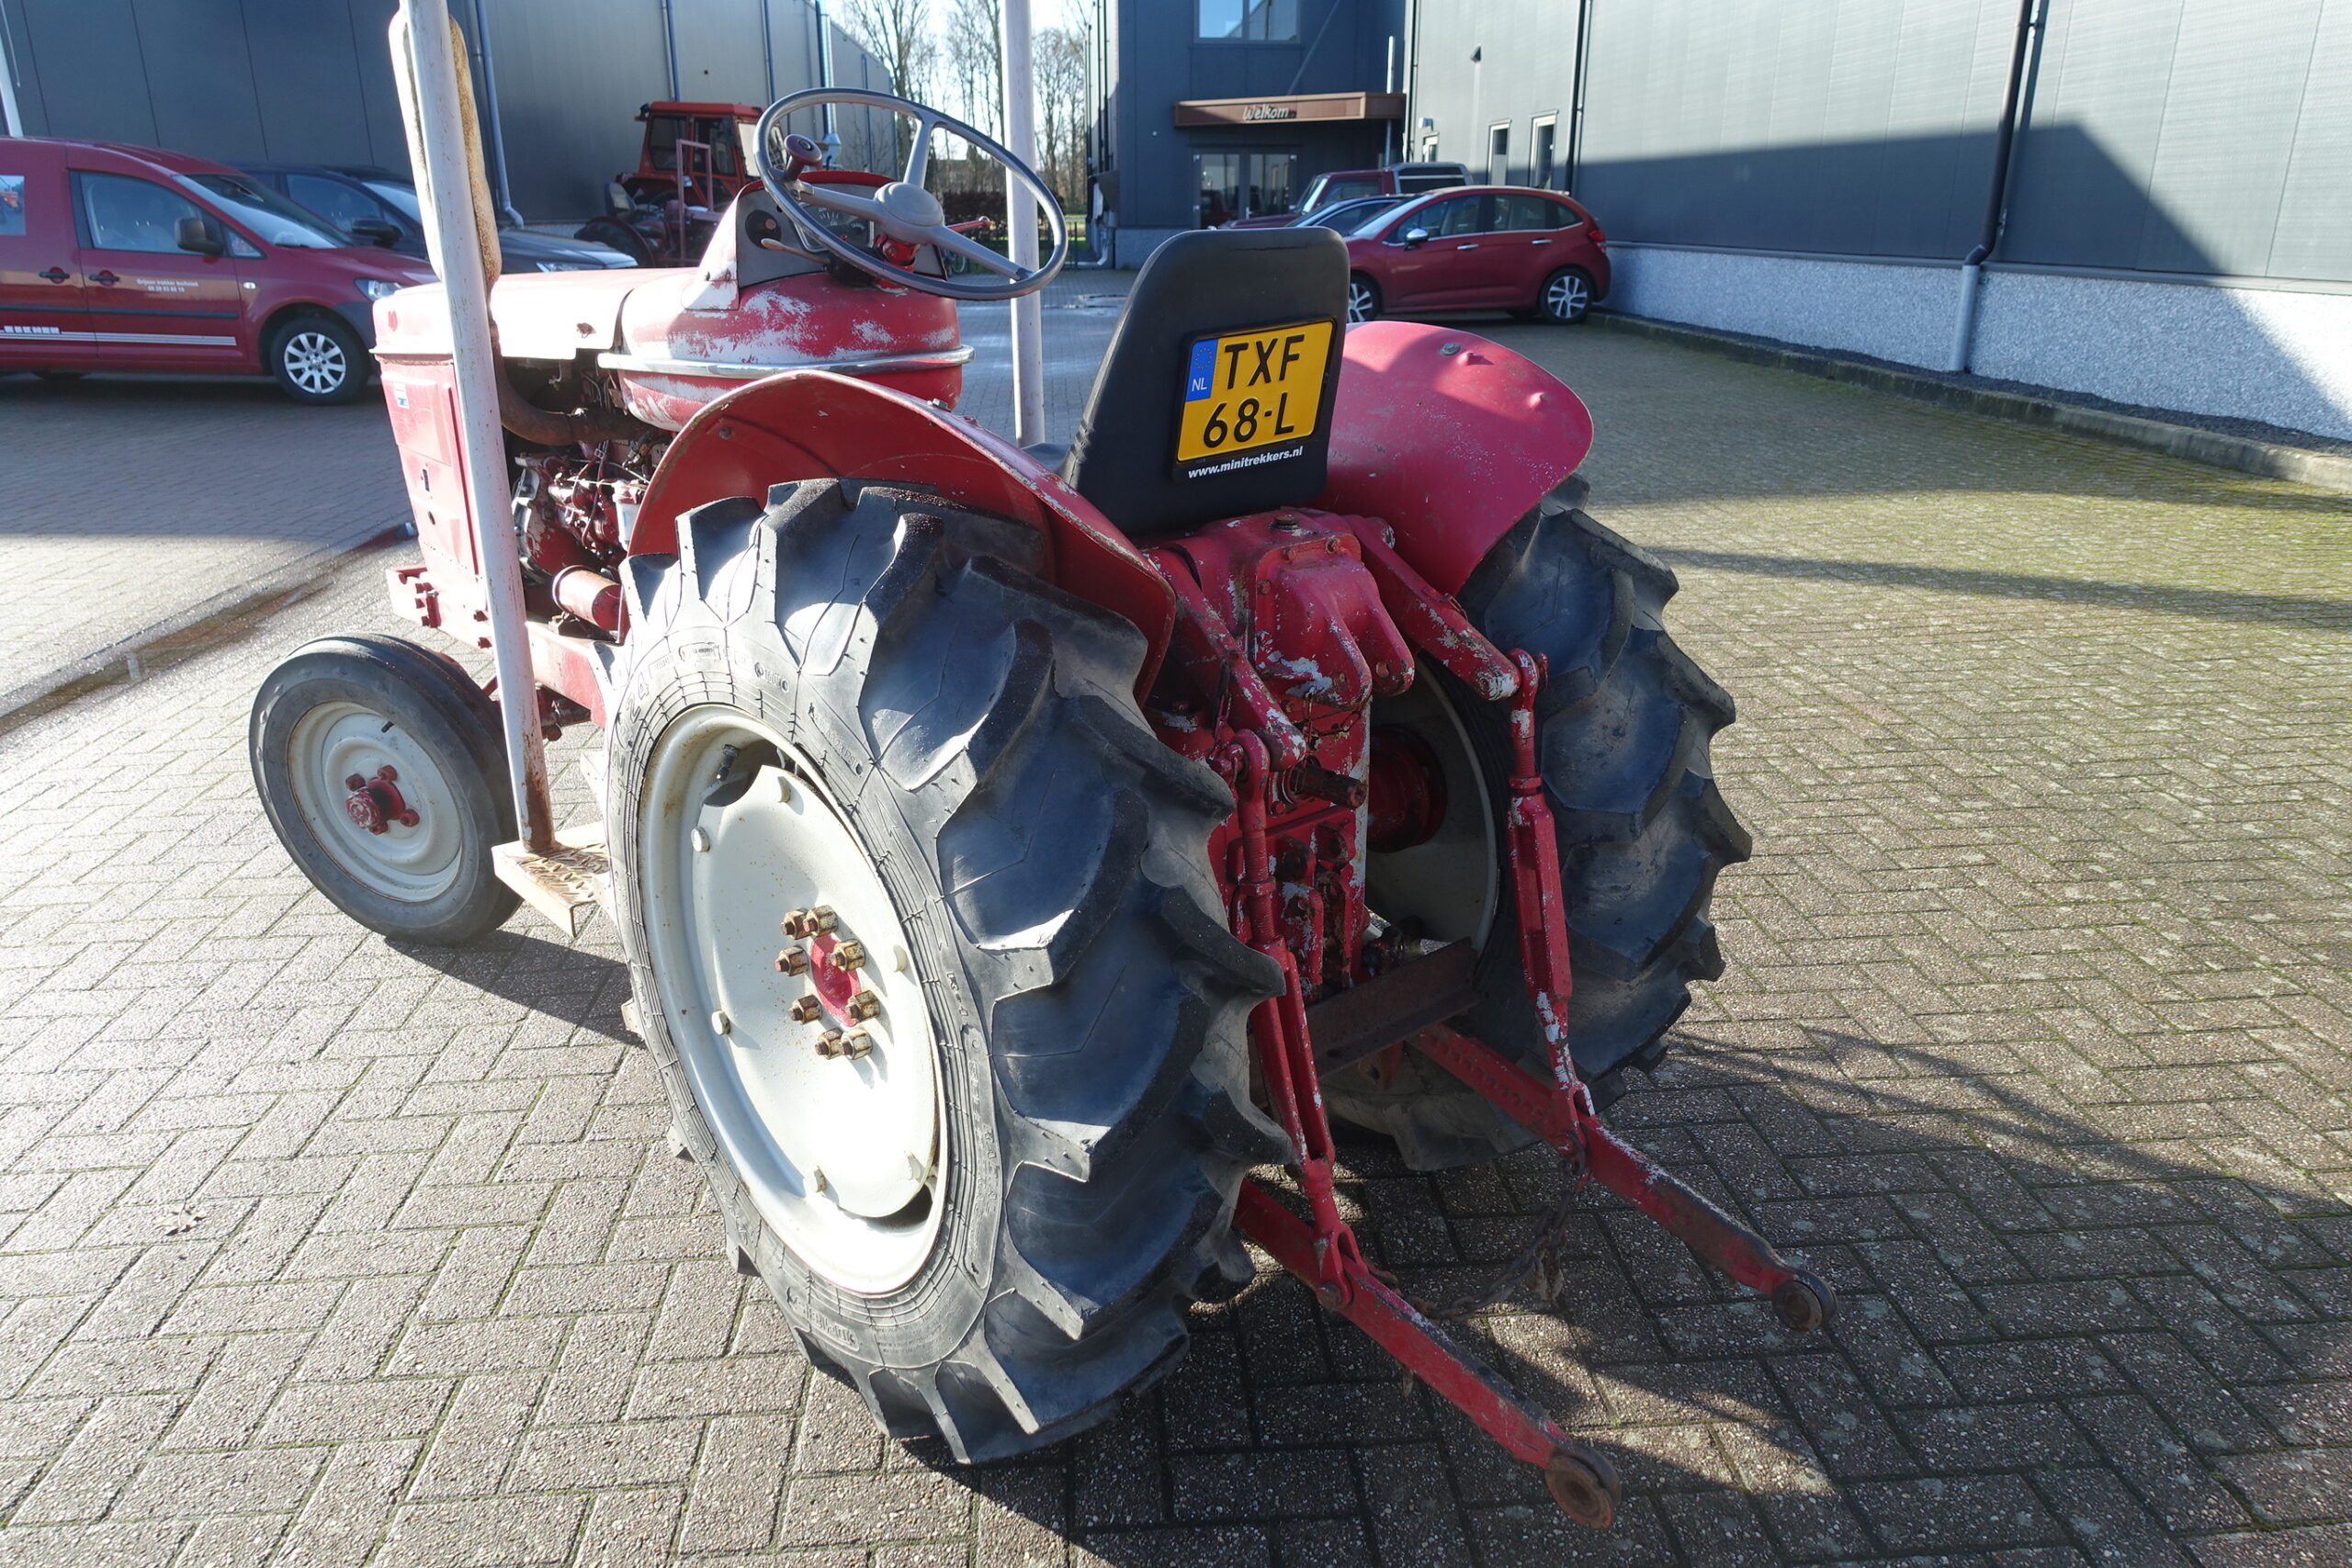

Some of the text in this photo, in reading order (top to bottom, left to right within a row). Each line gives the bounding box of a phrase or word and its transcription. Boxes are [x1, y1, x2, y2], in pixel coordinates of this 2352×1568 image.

[1242, 104, 1290, 120] Welkom
[1224, 333, 1305, 389] TXF
[1192, 377, 1207, 392] NL
[1203, 392, 1295, 448] 68-L
[1188, 446, 1304, 479] www.minitrekkers.nl
